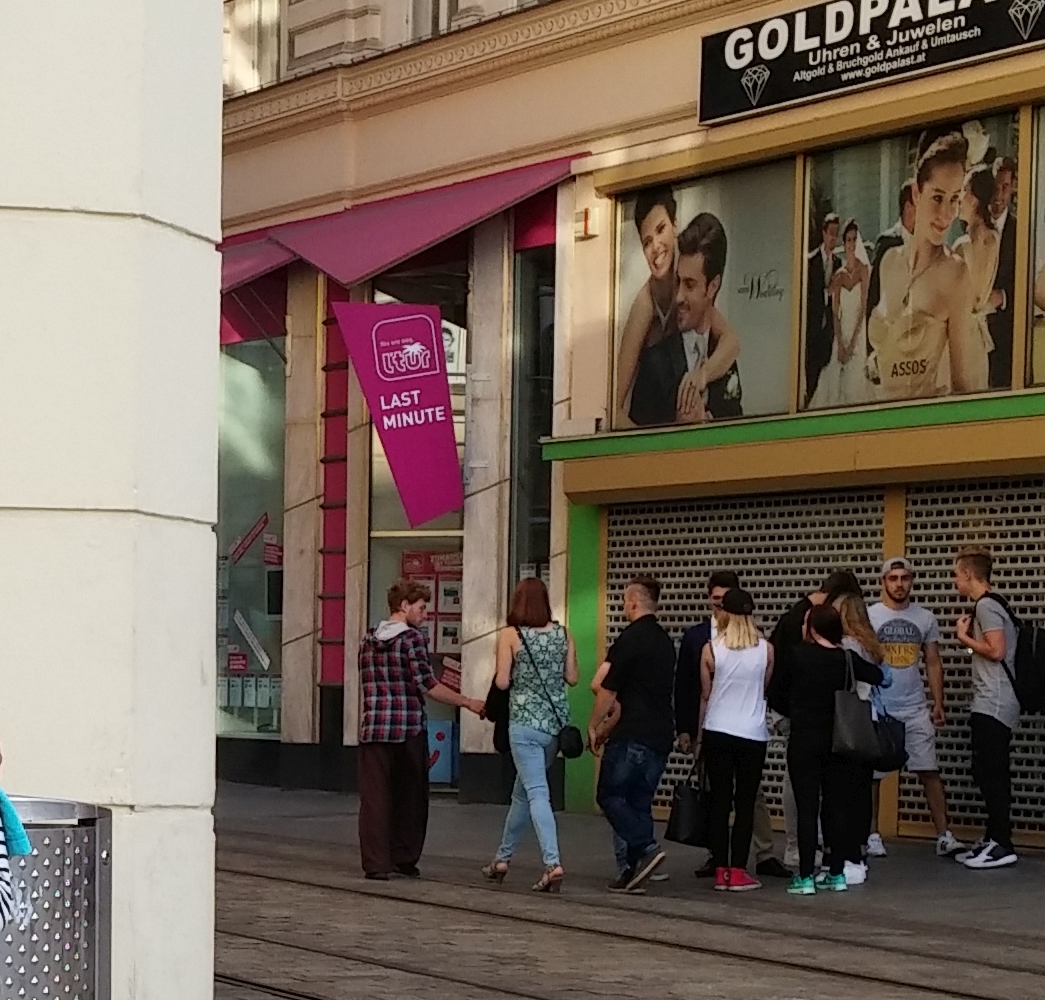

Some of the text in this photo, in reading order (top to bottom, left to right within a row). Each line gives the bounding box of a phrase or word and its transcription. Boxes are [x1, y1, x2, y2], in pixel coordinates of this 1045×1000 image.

[724, 0, 996, 70] GOLDPAL
[808, 15, 966, 66] Uhren & Juwelen
[792, 25, 982, 82] Altgold & Bruchgold Ankauf & Umtausch
[841, 52, 927, 82] www.goldpalast.at
[890, 359, 927, 378] ASSOS
[380, 389, 421, 411] LAST
[383, 406, 446, 431] MINUTE
